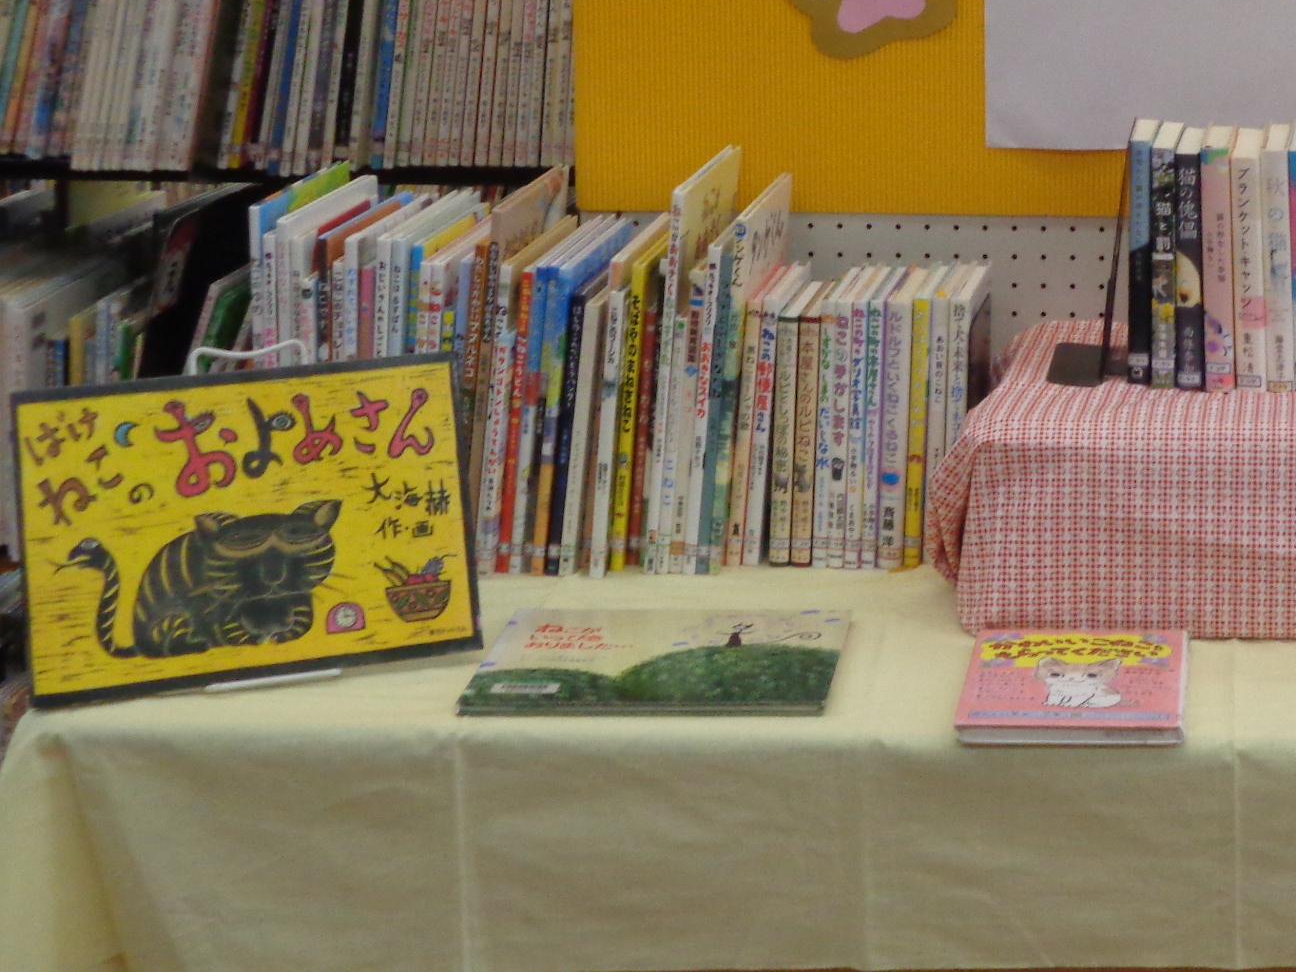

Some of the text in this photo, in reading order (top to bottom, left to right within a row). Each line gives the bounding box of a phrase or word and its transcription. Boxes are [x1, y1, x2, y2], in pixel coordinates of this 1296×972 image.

[155, 387, 435, 498] およめさん
[535, 623, 604, 633] ねこが
